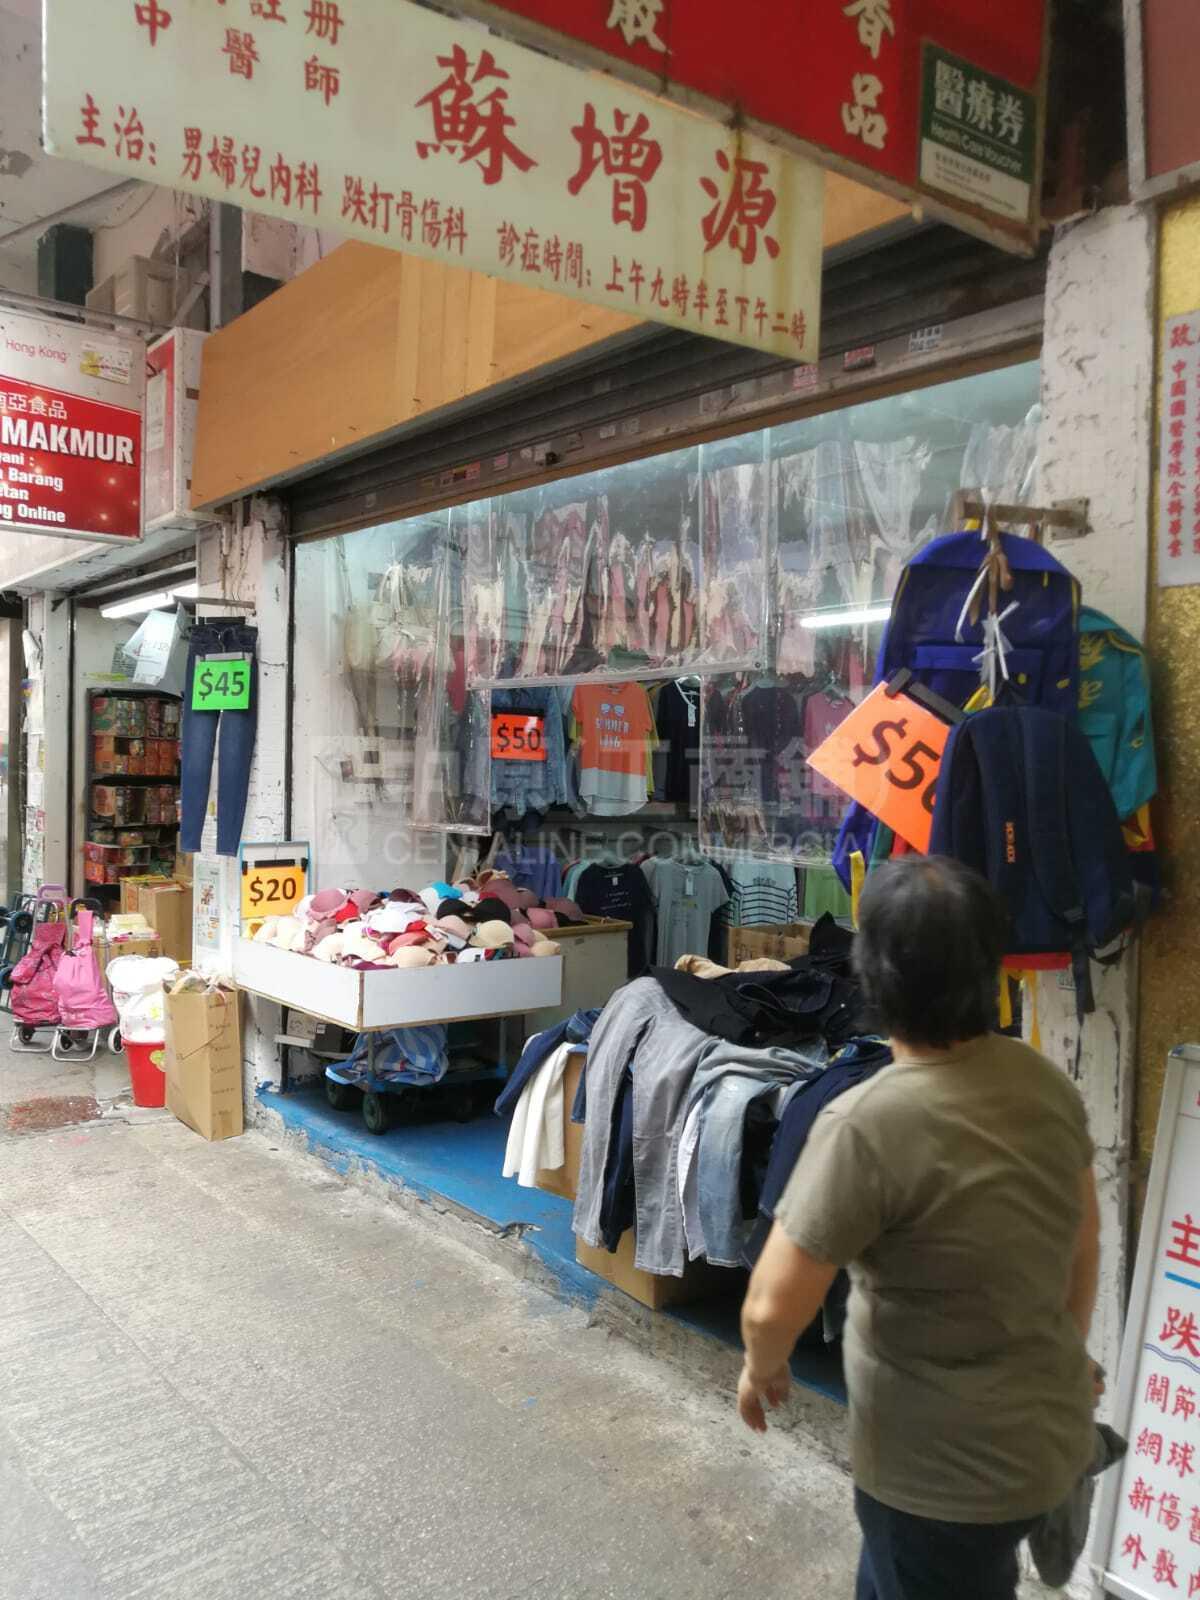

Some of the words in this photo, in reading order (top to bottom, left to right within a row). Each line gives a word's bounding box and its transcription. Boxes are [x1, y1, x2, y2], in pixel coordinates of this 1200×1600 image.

[934, 58, 1025, 146] 醫療券
[415, 43, 784, 266] 蘇增源
[6, 339, 36, 358] Hong
[38, 345, 69, 363] Kong
[1, 415, 135, 466] MAKMUR
[8, 466, 64, 493] Barang
[17, 503, 66, 523] Online
[199, 670, 246, 702] $45
[497, 723, 541, 753] $50
[249, 875, 297, 906] $20
